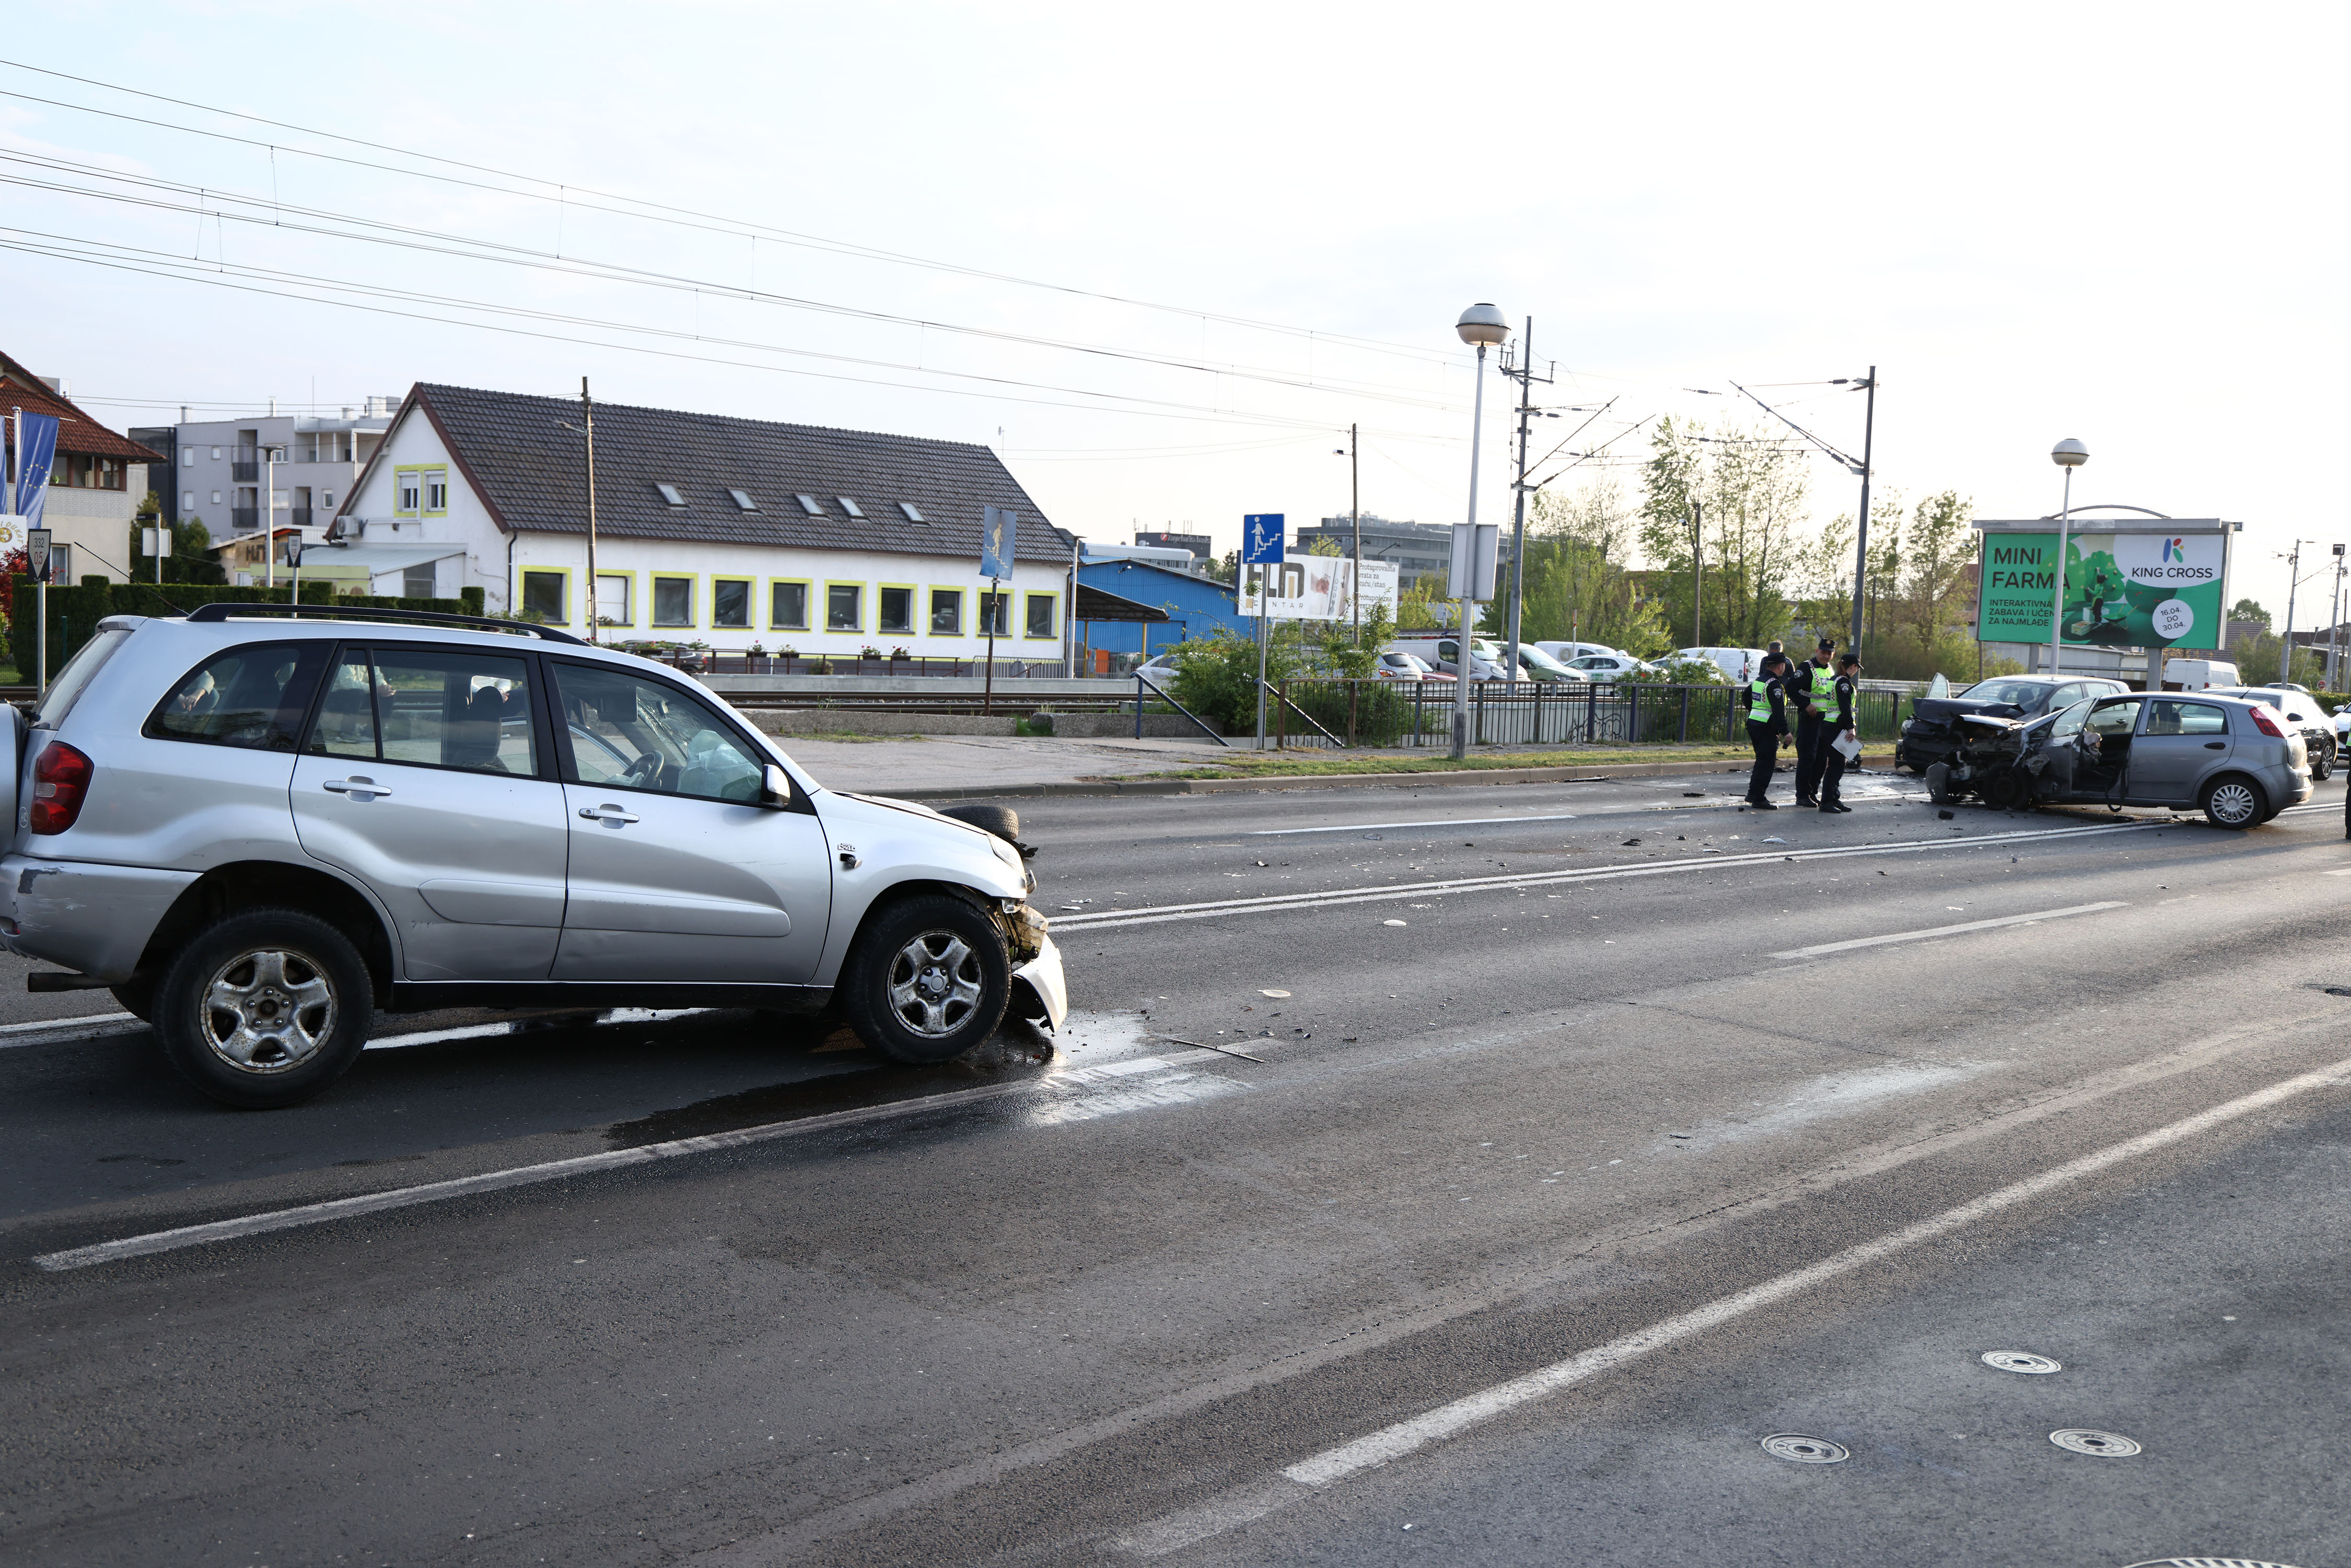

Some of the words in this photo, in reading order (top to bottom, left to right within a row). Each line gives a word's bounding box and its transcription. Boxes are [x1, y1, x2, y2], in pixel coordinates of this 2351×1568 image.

[5, 521, 24, 544] DUKAT
[34, 538, 44, 548] 332
[1994, 547, 2041, 565] MINI
[1359, 563, 1395, 572] Protuprovalna
[2132, 567, 2163, 577] KING
[2167, 567, 2213, 578] CROSS
[1993, 572, 2070, 590] FARMA
[1254, 600, 1303, 609] CNTAR
[1990, 599, 2053, 608] INTERAKTIVNA
[2032, 609, 2066, 618] UČENE
[2160, 607, 2182, 616] 16.04.
[2003, 618, 2049, 626] NAJMLAĐE
[2162, 622, 2186, 631] 30.04.
[21, 812, 27, 823] HR
